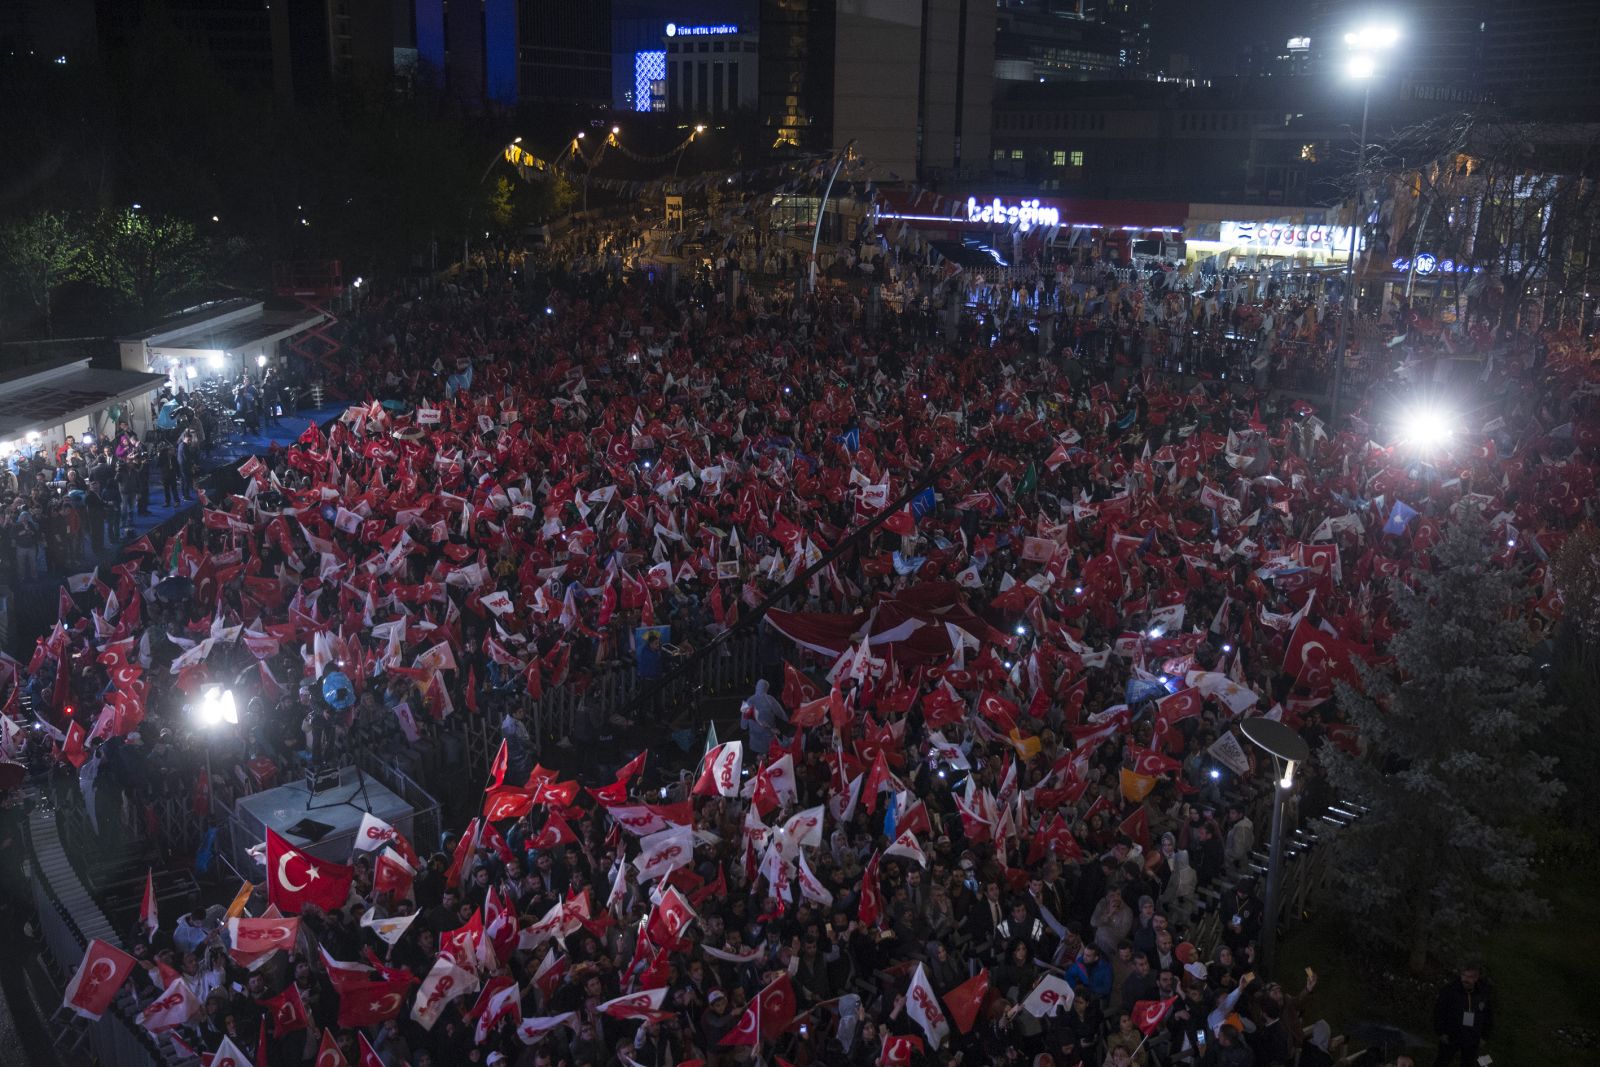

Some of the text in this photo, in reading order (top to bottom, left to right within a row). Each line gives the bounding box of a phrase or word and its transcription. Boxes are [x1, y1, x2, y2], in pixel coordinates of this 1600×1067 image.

[678, 26, 691, 35] TÜRK
[692, 26, 709, 35] METAL
[967, 196, 1059, 232] bebeğim
[720, 751, 735, 790] evet
[912, 985, 945, 1028] evet
